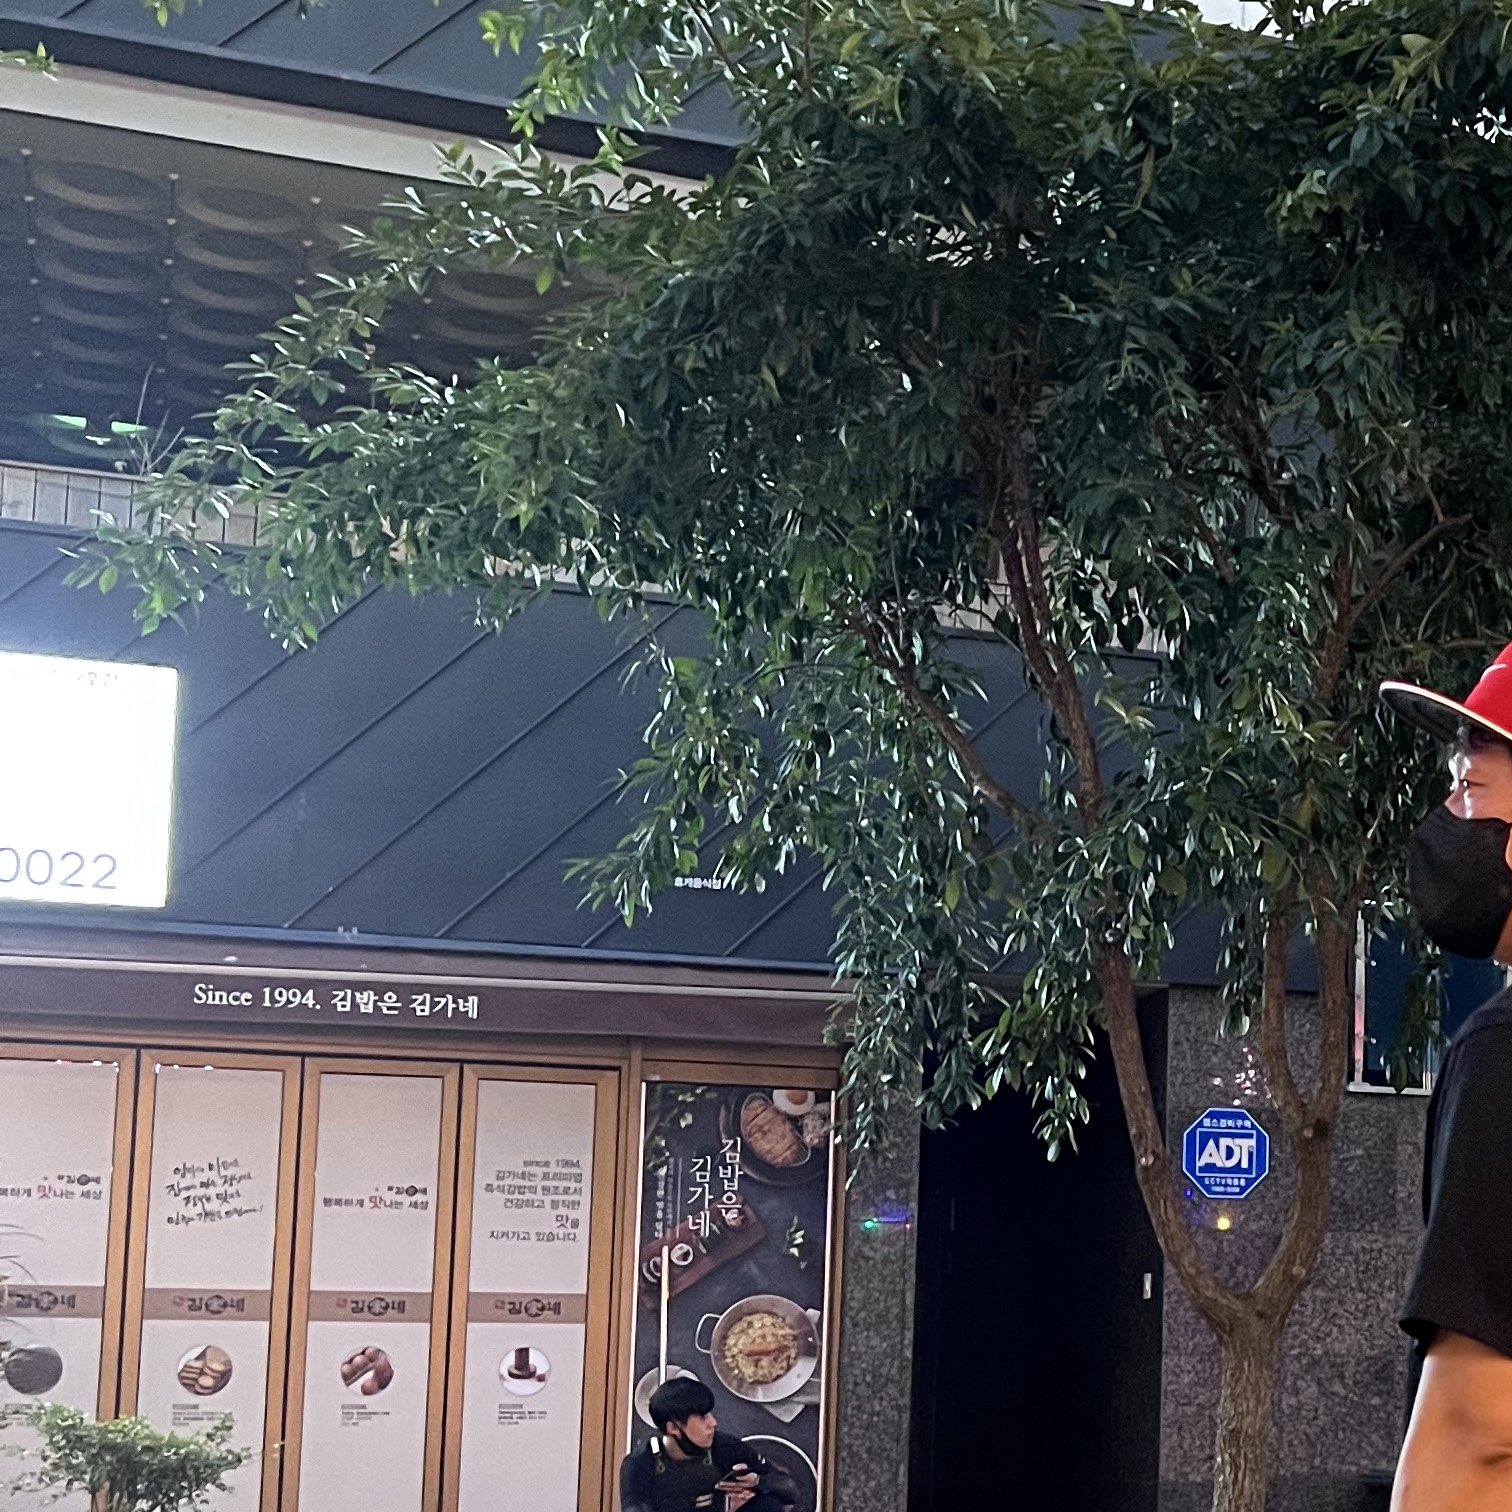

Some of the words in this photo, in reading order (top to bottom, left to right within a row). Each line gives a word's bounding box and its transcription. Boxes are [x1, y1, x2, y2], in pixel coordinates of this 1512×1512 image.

[193, 983, 253, 1006] Since
[262, 986, 322, 1010] 1994.
[331, 988, 403, 1015] 김밥은
[409, 993, 480, 1020] 김가네
[1198, 1137, 1256, 1169] ADT
[495, 1170, 538, 1182] 김가네는
[716, 1136, 744, 1226] 김밥은
[687, 1155, 715, 1237] 김가네
